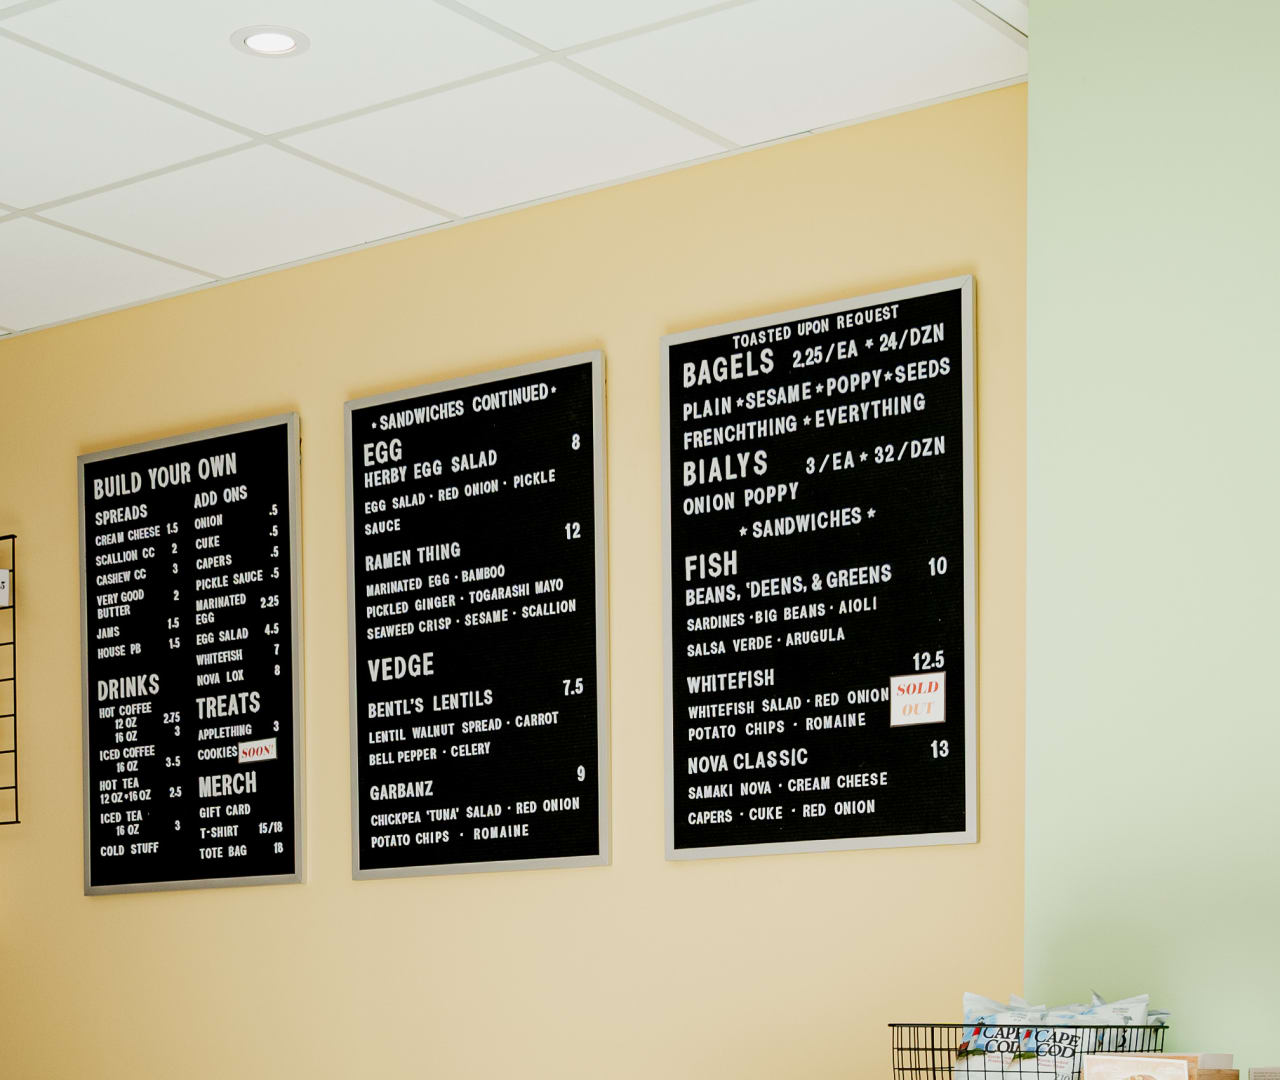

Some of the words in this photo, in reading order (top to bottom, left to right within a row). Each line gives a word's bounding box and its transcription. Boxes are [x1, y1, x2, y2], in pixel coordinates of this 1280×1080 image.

[733, 326, 791, 349] TOASTED
[798, 318, 829, 336] UPON
[837, 304, 899, 329] REQUEST
[684, 348, 774, 388] BAGELS
[364, 439, 402, 466] EGG
[365, 466, 407, 488] HERBY
[414, 460, 442, 479] EGG
[451, 450, 497, 472] SALAD
[572, 433, 580, 450] 8
[94, 472, 141, 500] BUILD
[148, 462, 191, 489] YOUR
[198, 452, 236, 480] OWN
[684, 450, 767, 486] BIALYS
[194, 491, 217, 508] ADD
[223, 485, 247, 503] ONS
[365, 500, 386, 514] EGG
[392, 493, 425, 509] SALAD
[438, 487, 459, 501] RED
[464, 479, 498, 496] ONION
[514, 469, 555, 488] PICKLE
[683, 492, 734, 515] ONION
[745, 482, 798, 507] POPPY
[96, 504, 147, 525] SPREADS
[195, 514, 222, 529] ONION
[365, 519, 400, 535] SAUCE
[95, 532, 124, 546] CREAM
[128, 525, 160, 541] CHEESE
[196, 535, 220, 549] CUKE
[366, 550, 411, 571] RAMEN
[417, 542, 460, 563] THING
[565, 522, 581, 539] 12
[196, 554, 232, 569] CAPERS
[685, 550, 737, 581] FISH
[96, 571, 131, 586] CASHEW
[134, 569, 146, 580] CC
[196, 575, 228, 591] PICKLE
[233, 570, 263, 584] SAUCE
[686, 584, 741, 606] BEANS,
[812, 573, 822, 591] &
[826, 564, 892, 588] GREENS
[929, 556, 947, 576] 10
[687, 641, 725, 657] SALSA
[733, 635, 772, 652] VERDE
[786, 627, 845, 646] ARUGULA
[197, 673, 220, 686] NOVA
[226, 669, 244, 682] LOX
[368, 652, 434, 682] VEDGE
[687, 669, 774, 694] WHITEFISH
[913, 650, 944, 670] 12.5
[98, 674, 159, 701] DRINKS
[368, 698, 424, 718] BENTL'S
[433, 689, 493, 711] LENTILS
[563, 678, 583, 696] 7.5
[896, 680, 939, 696] SOLD
[99, 707, 115, 718] HOT
[119, 702, 152, 716] COFFEE
[196, 691, 260, 719] TREATS
[901, 702, 934, 717] OUT
[198, 724, 252, 741] APPLETHING
[197, 746, 238, 760] COOKIES
[688, 755, 728, 774] NOVA
[734, 748, 808, 769] CLASSIC
[931, 740, 949, 758] 13
[199, 771, 256, 798] MERCH
[370, 780, 433, 800] GARBANZ
[577, 765, 585, 781] 9
[200, 806, 221, 818] GIFT
[226, 804, 250, 816] CARD
[371, 811, 421, 826] CHICKPEA
[466, 804, 501, 818] SALAD
[516, 801, 537, 814] RED
[543, 797, 579, 812] ONION
[200, 825, 238, 839] T-SHIRT
[199, 847, 223, 859] TOTE
[228, 845, 247, 857] BAG
[274, 842, 283, 853] 18
[1035, 1030, 1080, 1048] CAPE
[1036, 1043, 1075, 1058] COD
